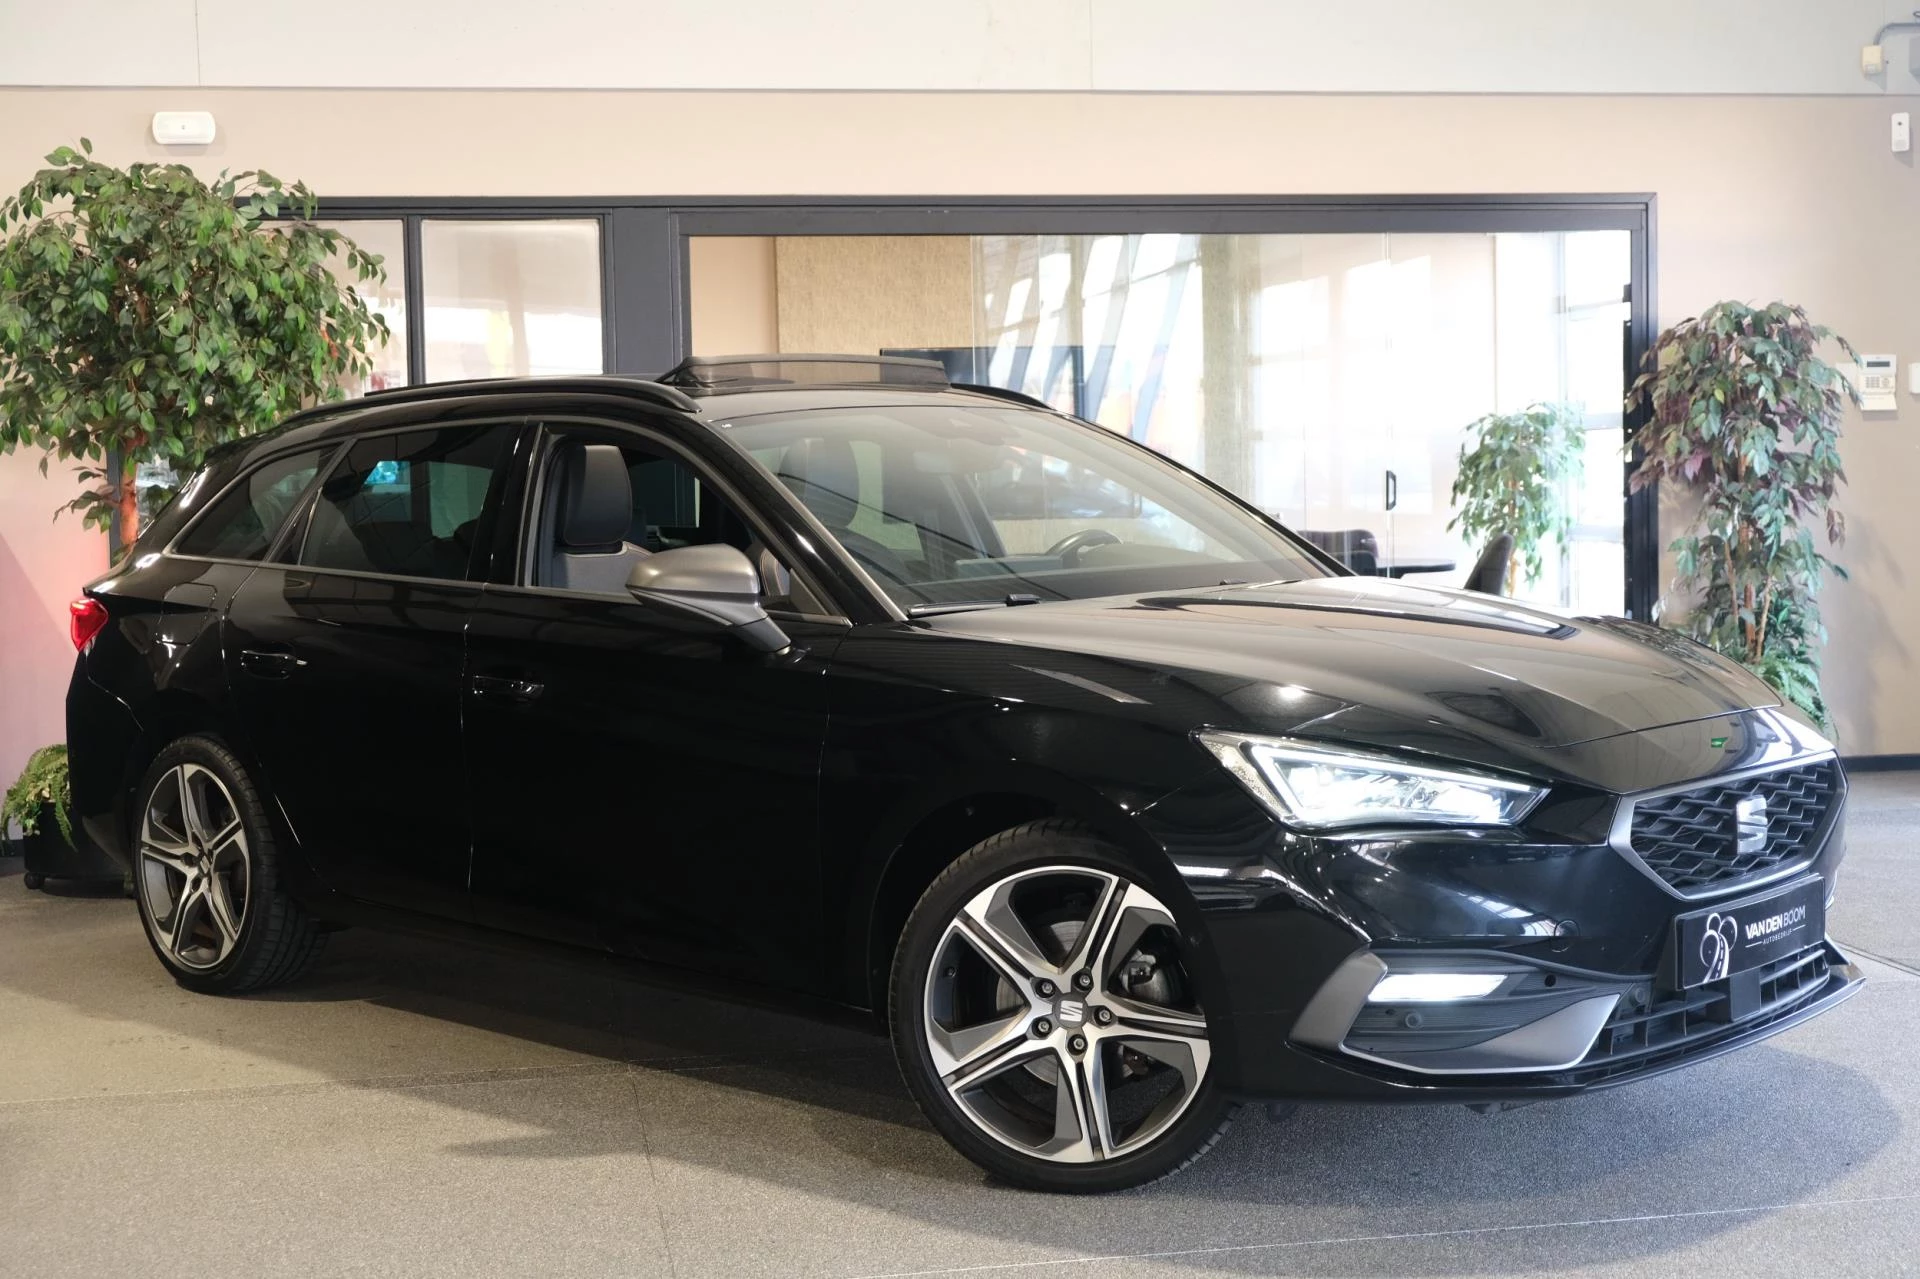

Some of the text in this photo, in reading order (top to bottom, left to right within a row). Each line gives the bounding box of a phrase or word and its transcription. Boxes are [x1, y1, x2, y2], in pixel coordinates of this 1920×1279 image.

[1745, 904, 1806, 940] VAN DEN BOOM
